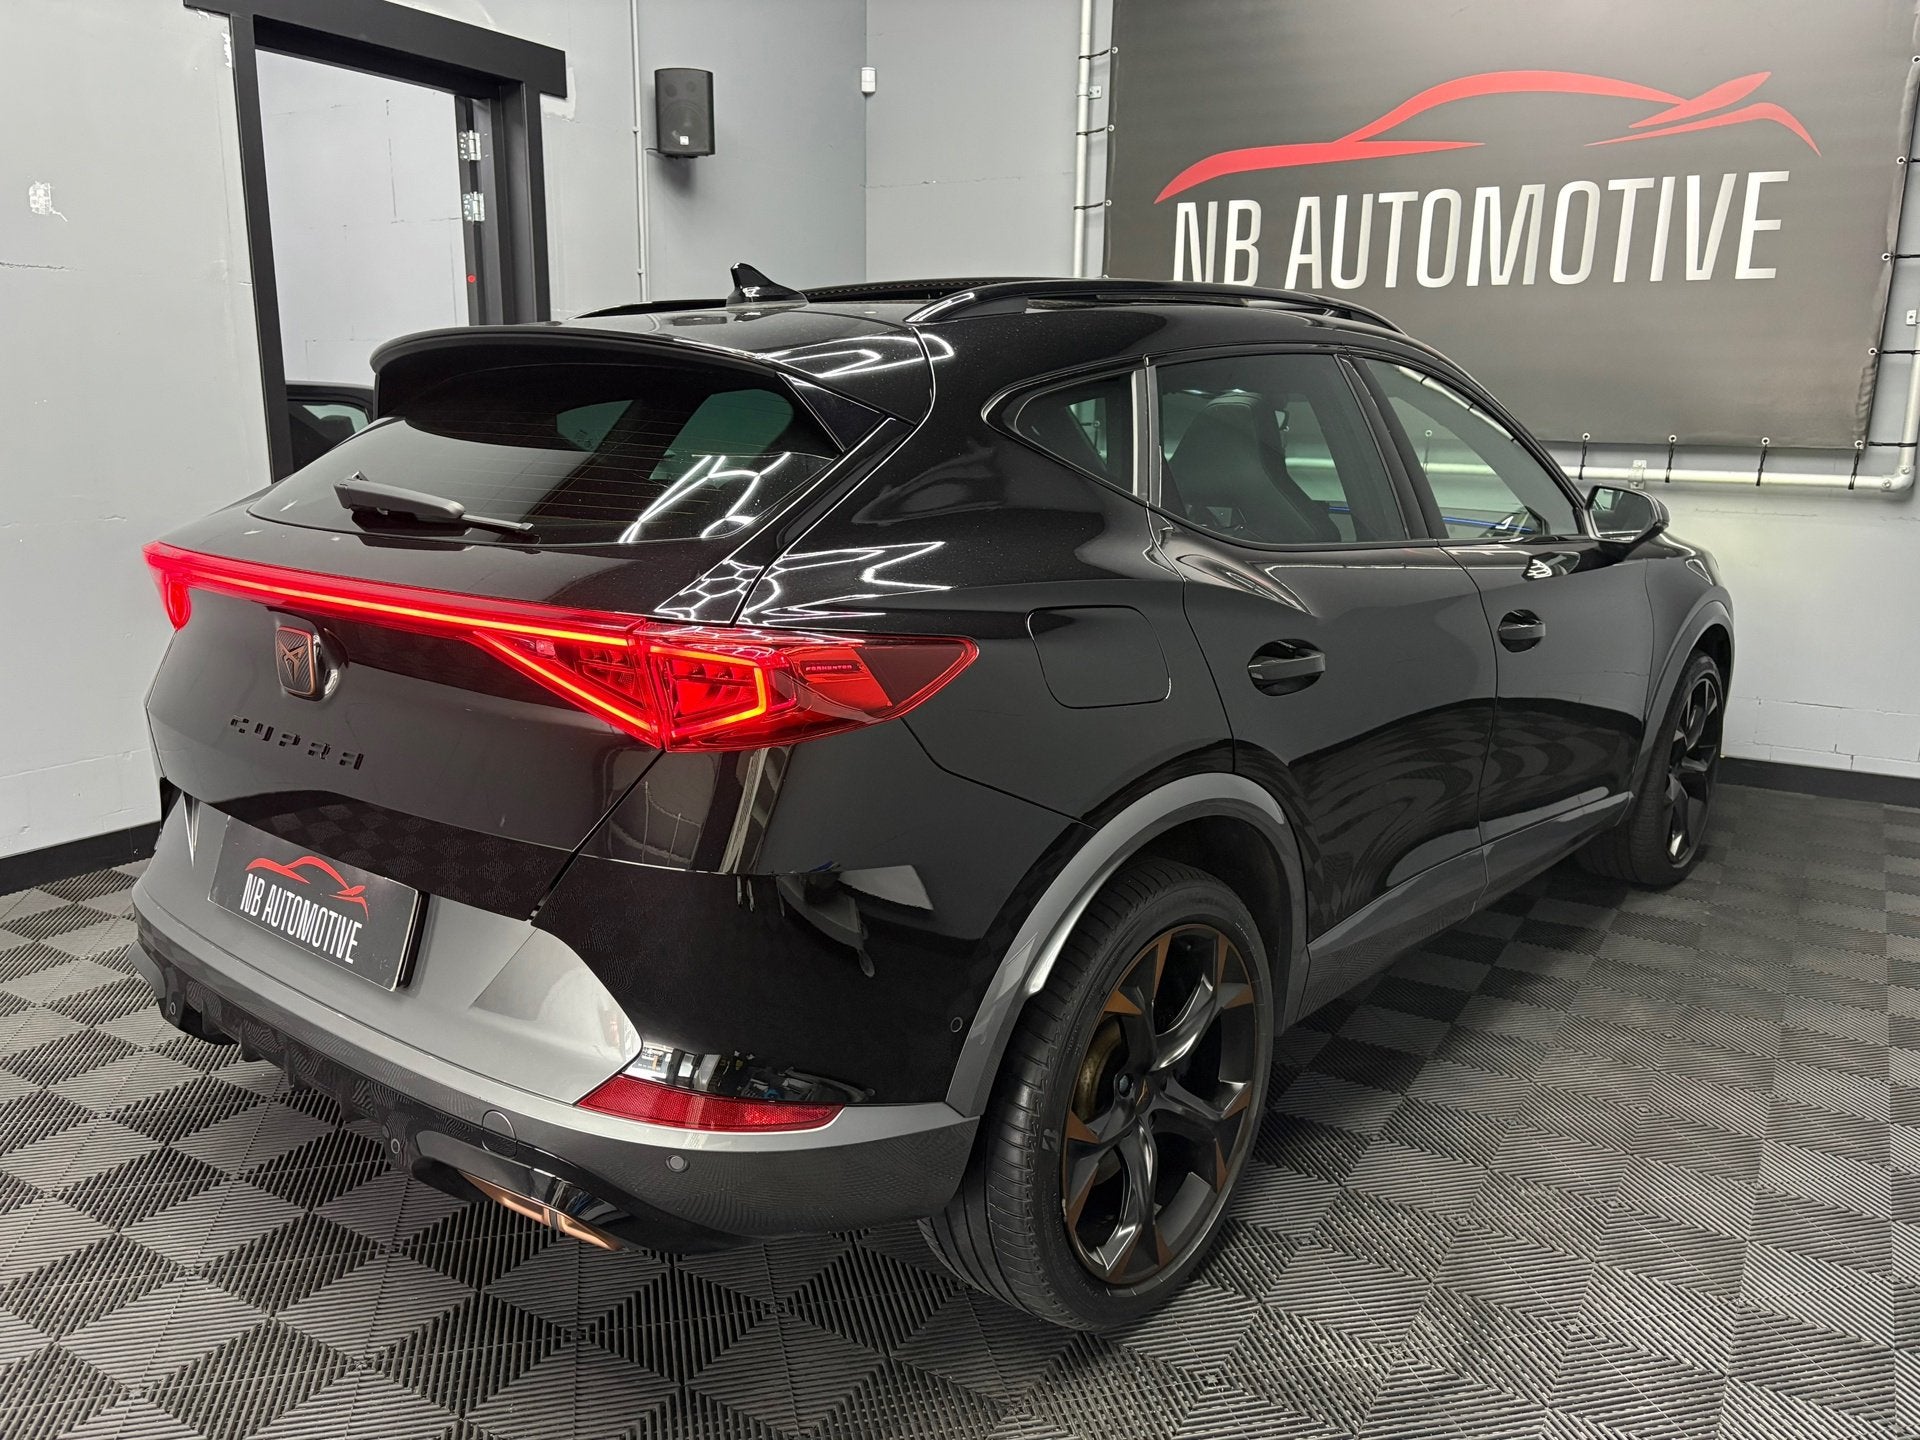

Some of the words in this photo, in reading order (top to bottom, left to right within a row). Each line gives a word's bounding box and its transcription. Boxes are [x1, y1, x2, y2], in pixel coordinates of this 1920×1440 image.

[1173, 199, 1262, 286] NB
[1284, 170, 1790, 290] AUTOMOTIVE
[230, 715, 364, 770] CUPRA
[239, 873, 266, 917] NB
[261, 884, 363, 964] AUTOMOTIVE
